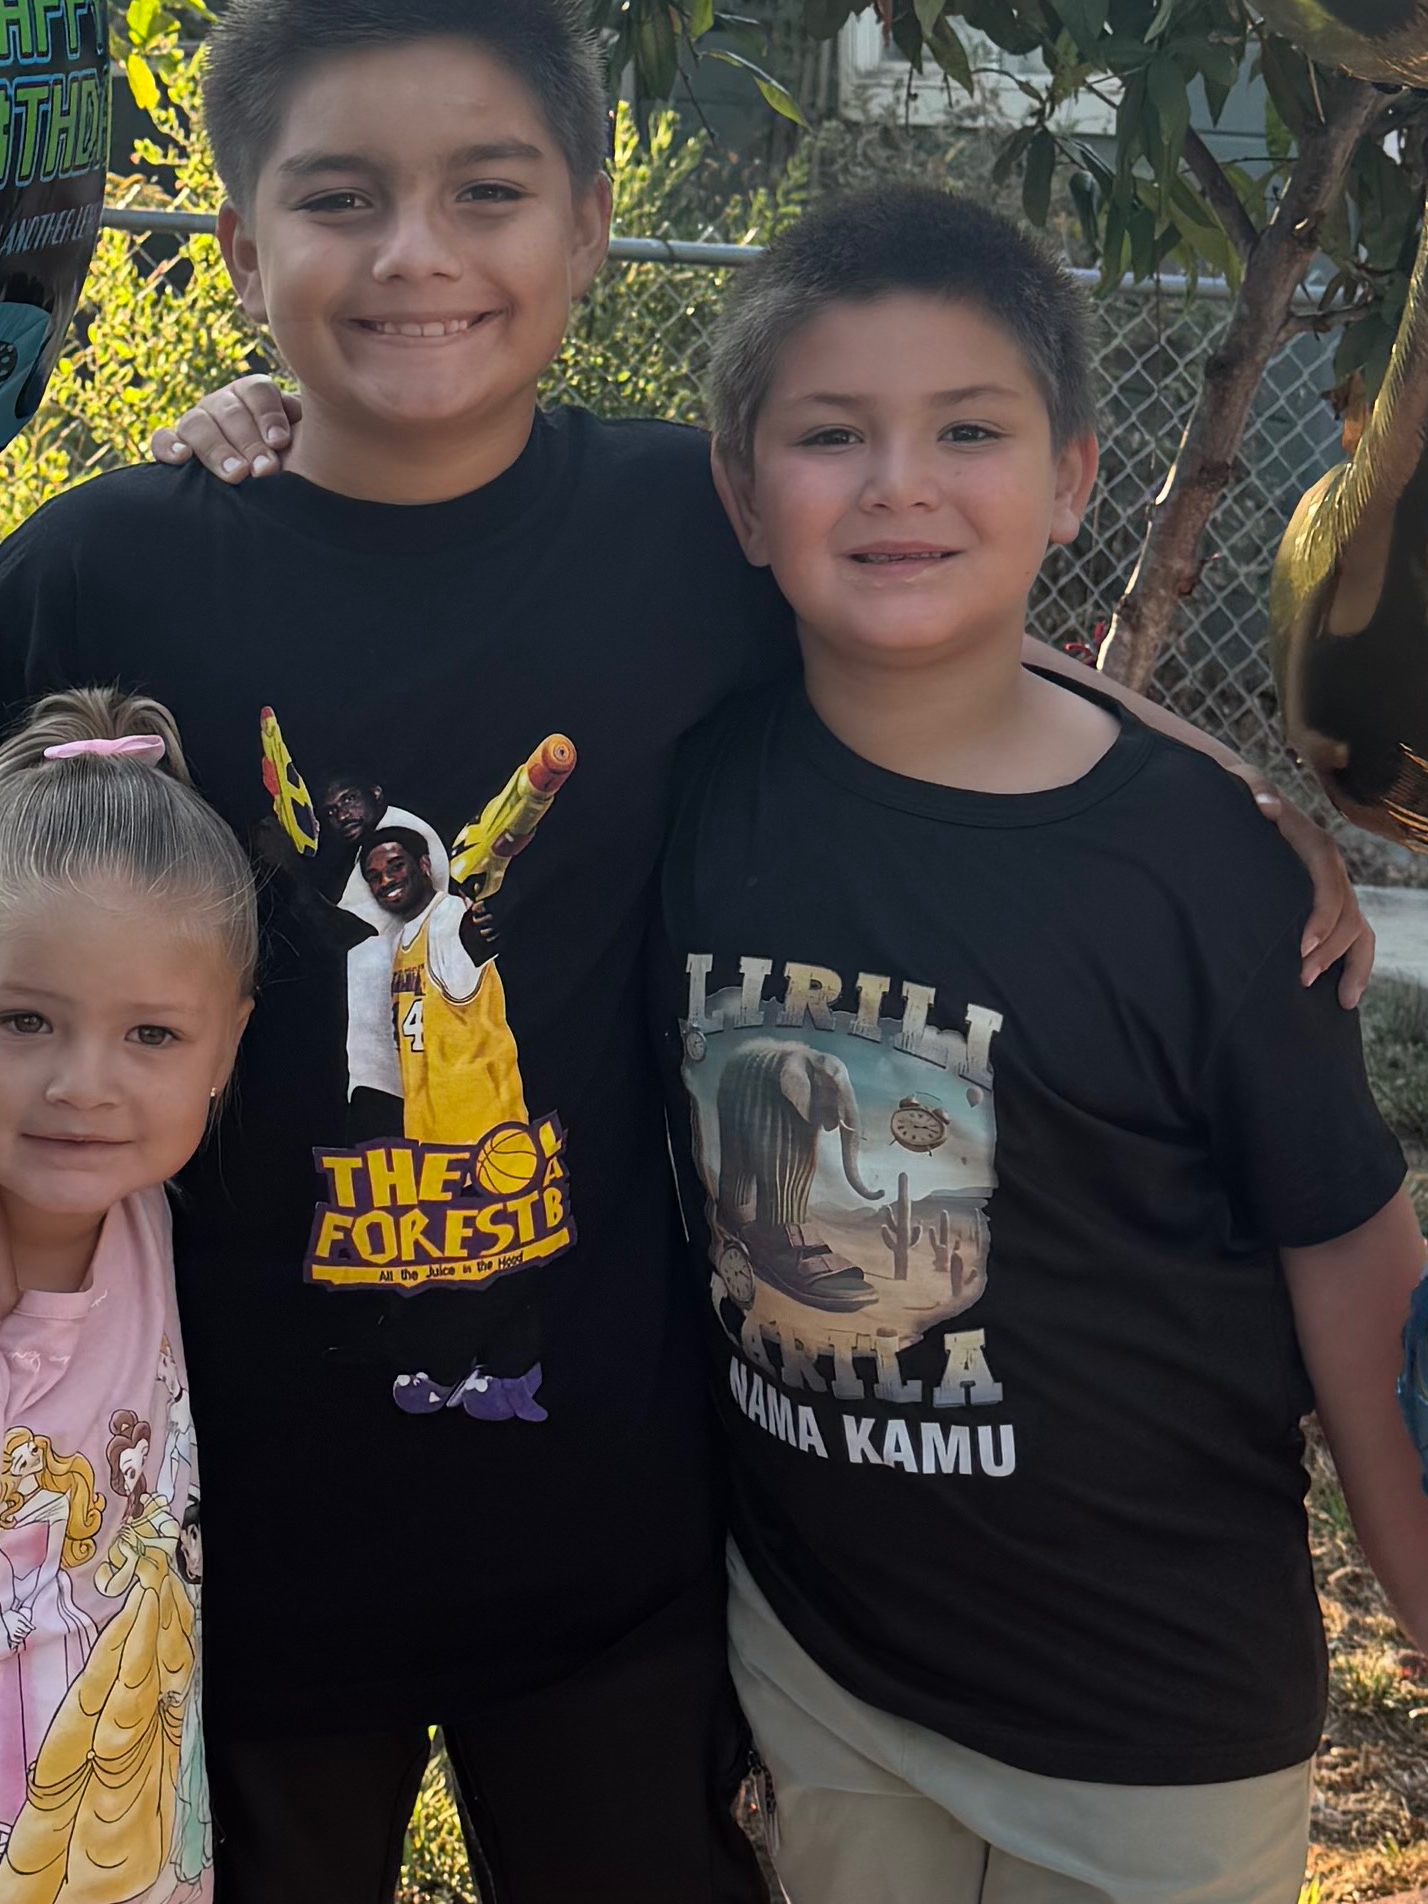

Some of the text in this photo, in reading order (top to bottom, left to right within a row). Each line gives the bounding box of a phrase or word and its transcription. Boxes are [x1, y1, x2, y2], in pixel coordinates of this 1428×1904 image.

[682, 953, 1003, 1091] LIRILI
[322, 1148, 470, 1208] THE
[315, 1190, 539, 1264] FOREST
[378, 1269, 394, 1282] All
[401, 1268, 419, 1281] the
[426, 1264, 456, 1278] Juice
[462, 1264, 472, 1274] in
[477, 1259, 494, 1273] the
[729, 1355, 1016, 1478] NAMA KAMU
